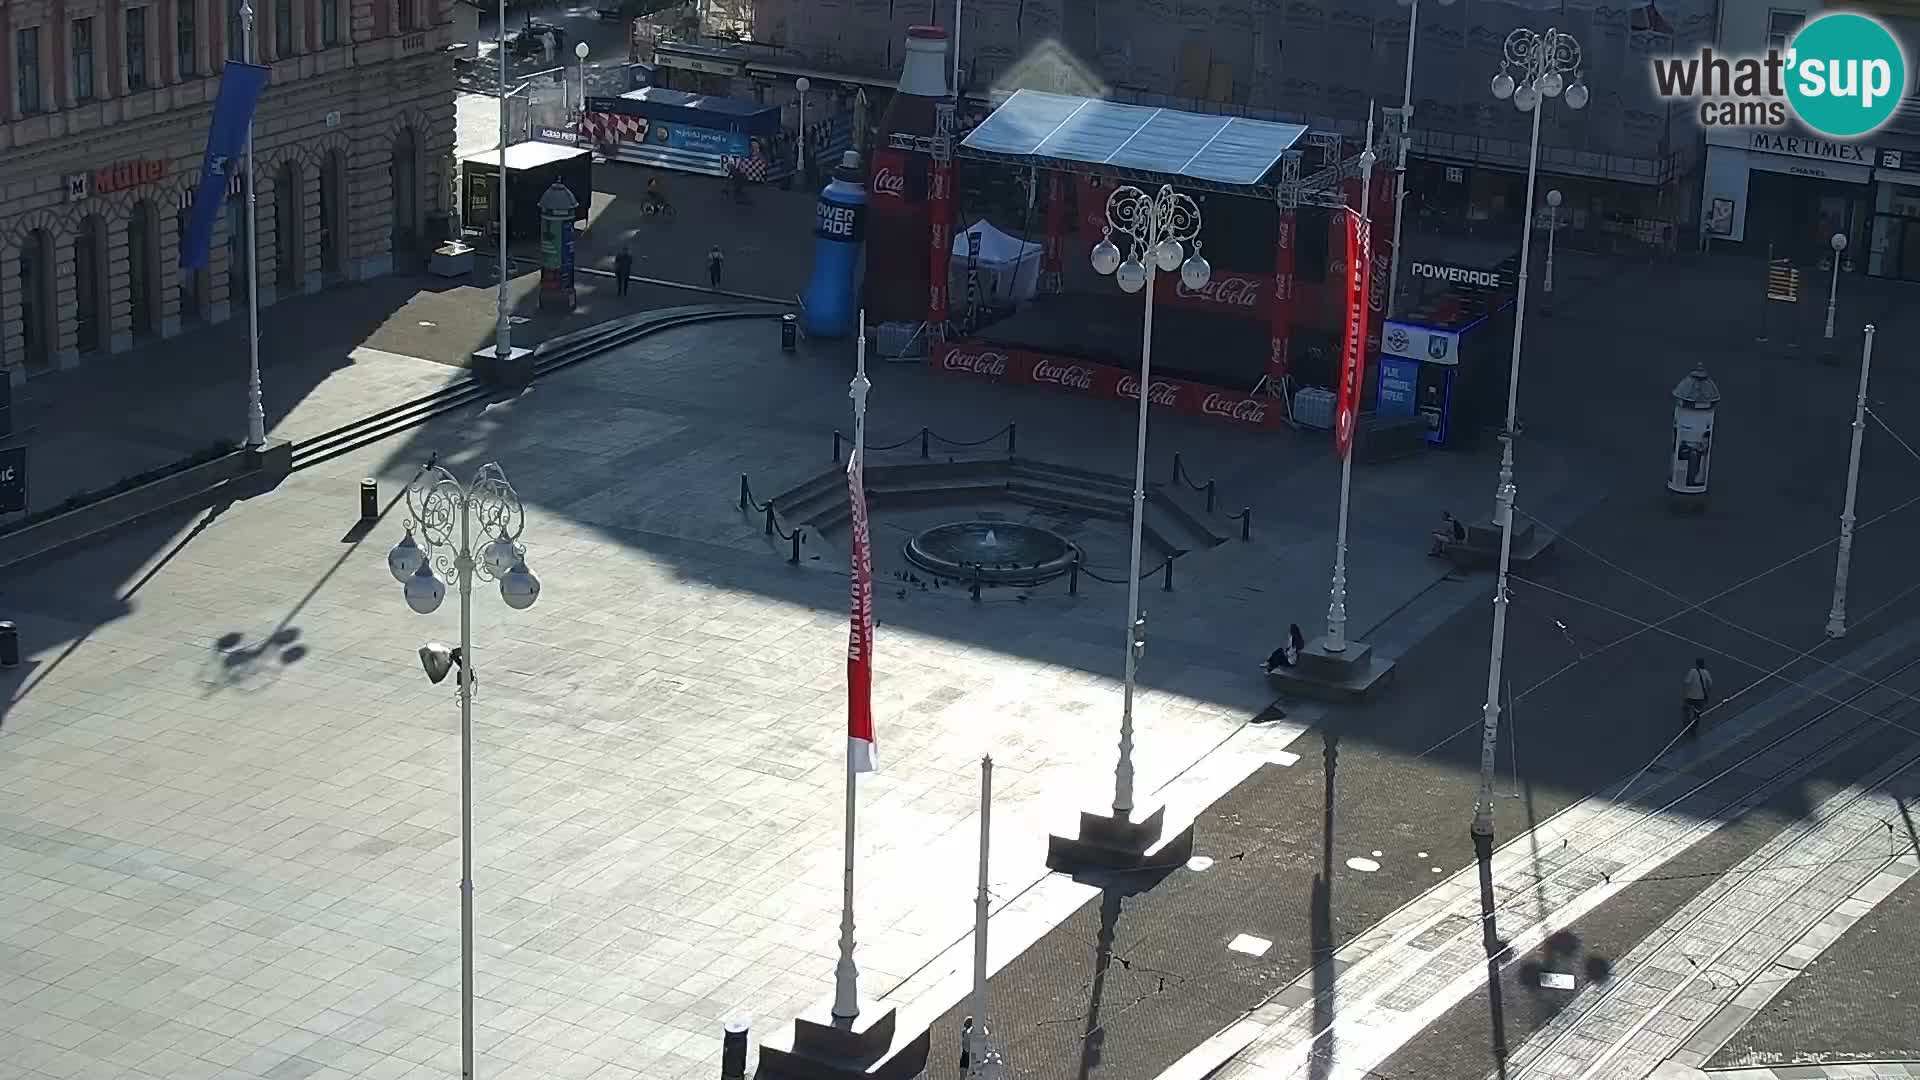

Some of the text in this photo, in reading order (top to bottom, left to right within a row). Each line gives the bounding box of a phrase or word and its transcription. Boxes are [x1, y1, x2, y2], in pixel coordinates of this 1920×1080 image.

[1754, 134, 1865, 161] MARTIMEX
[1790, 166, 1827, 177] CHANEL
[1412, 262, 1500, 287] POWERADE
